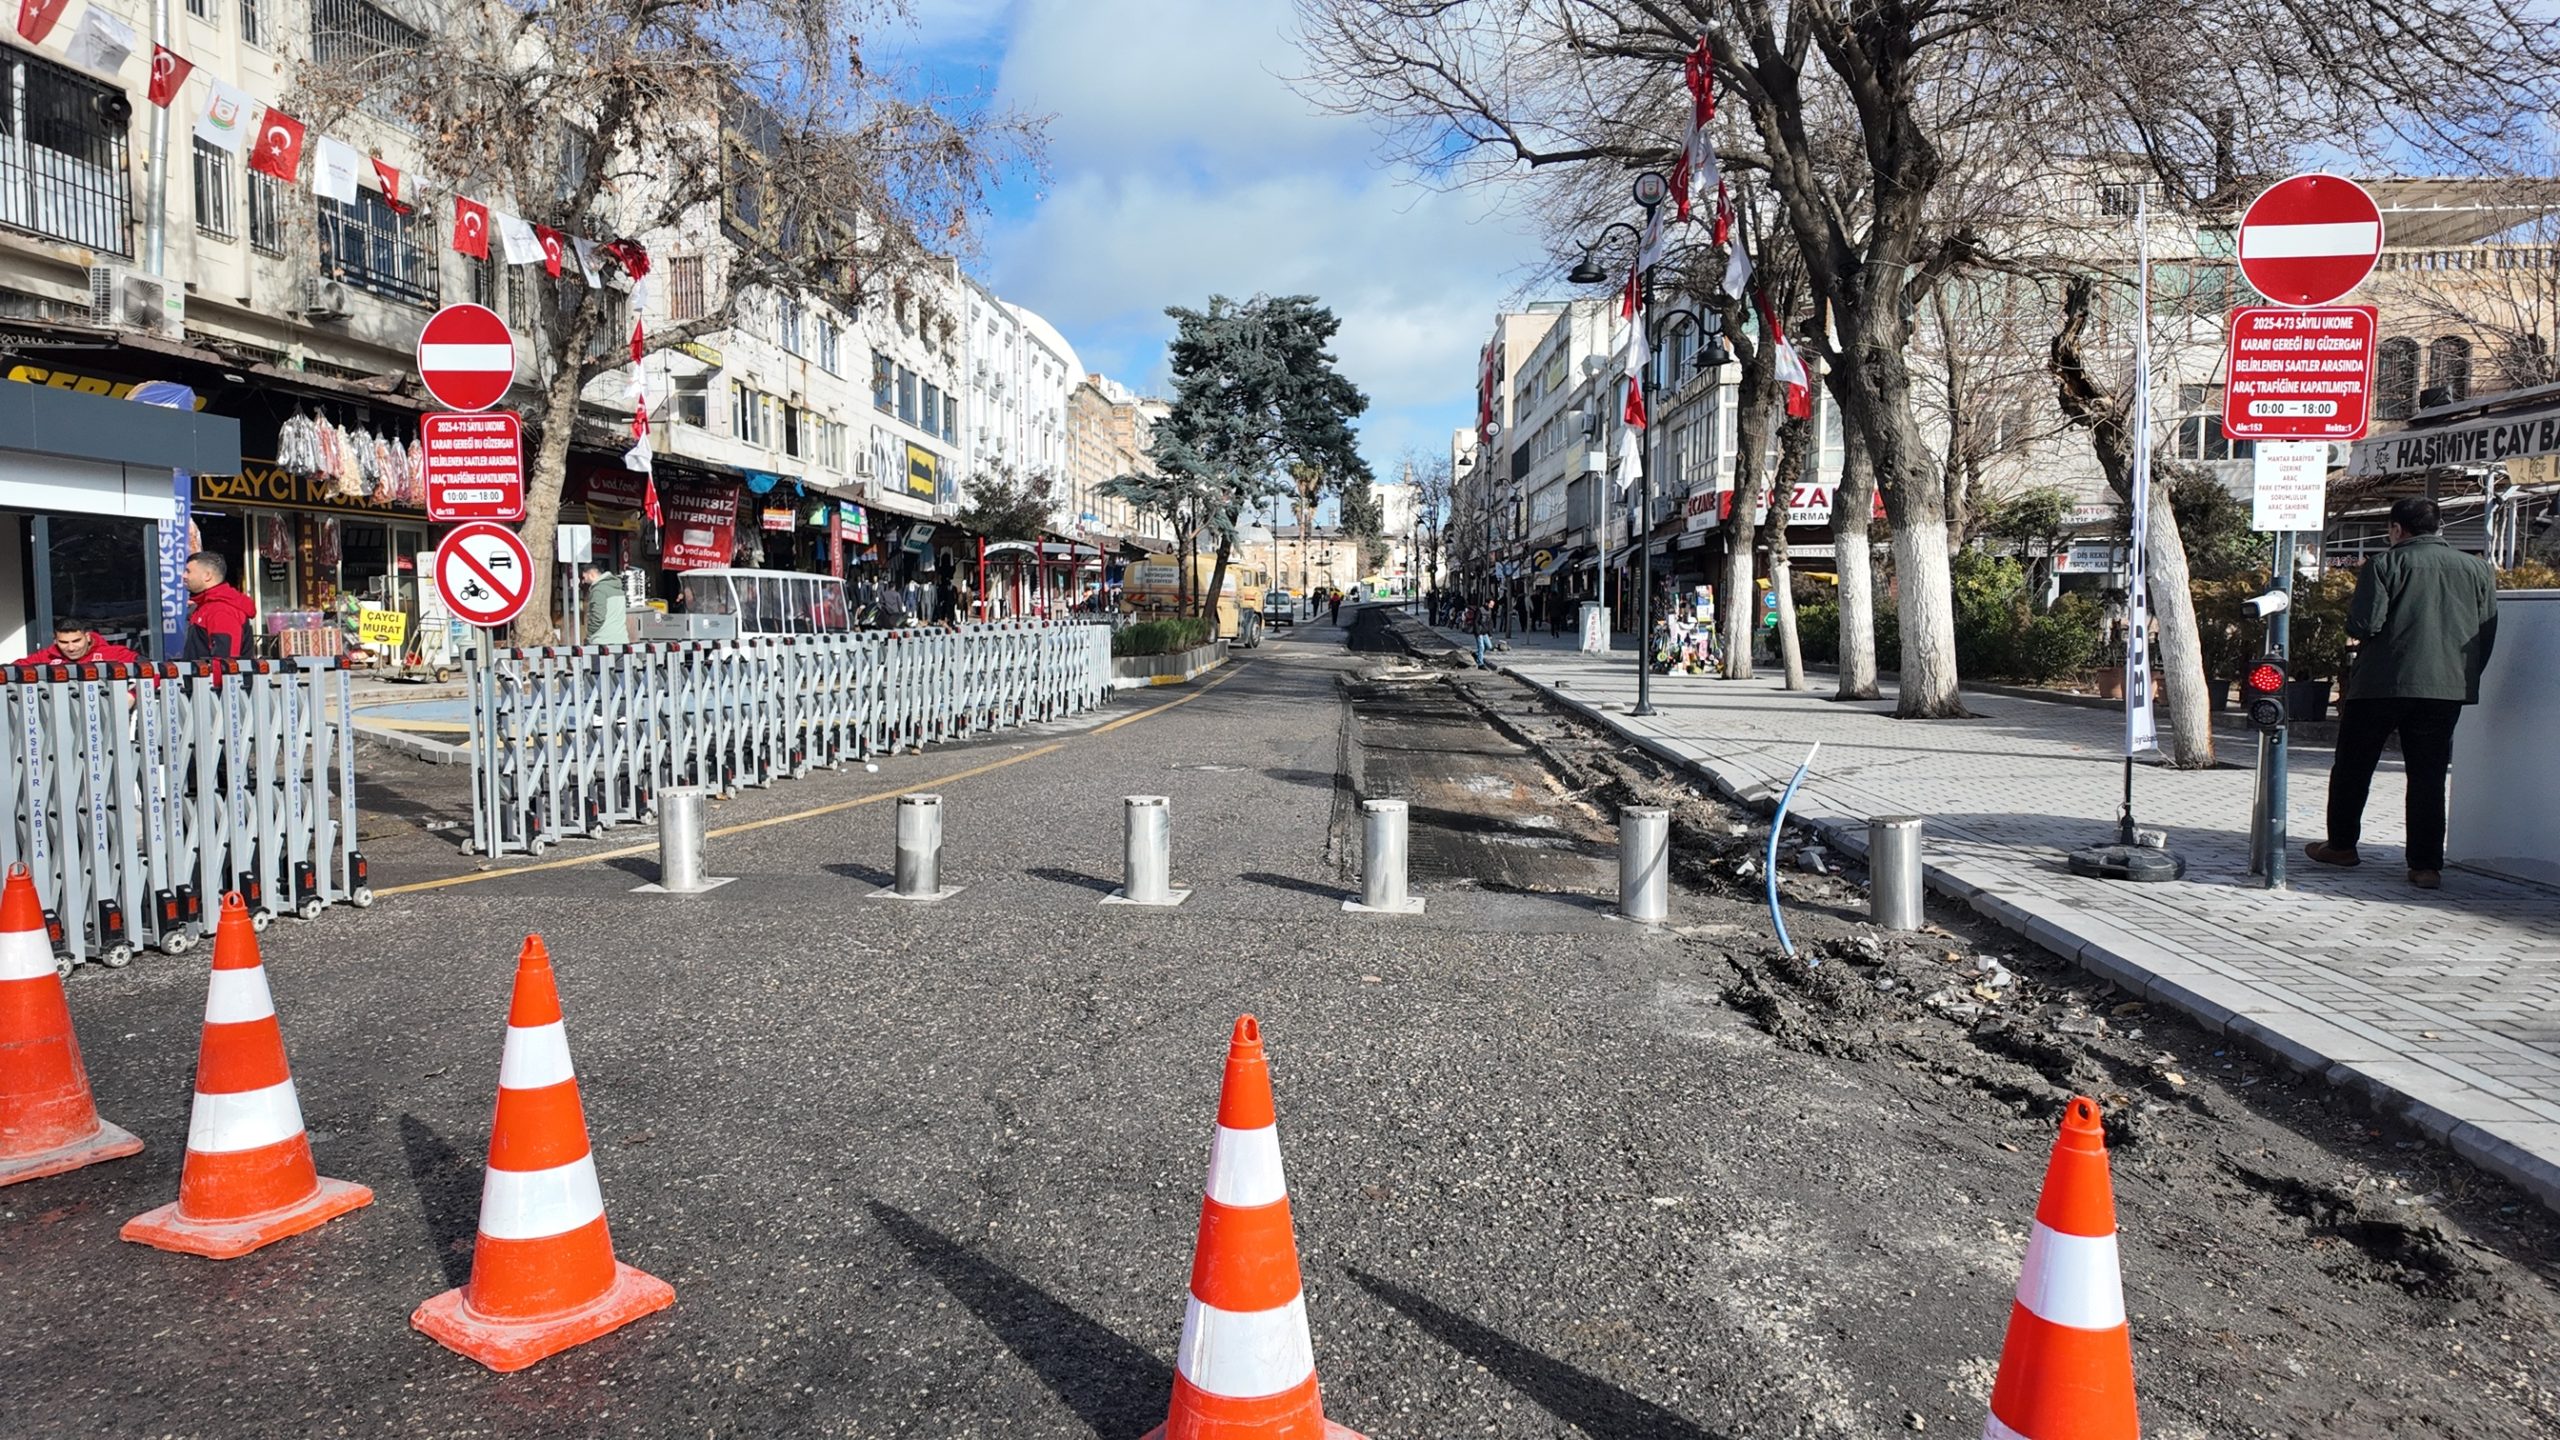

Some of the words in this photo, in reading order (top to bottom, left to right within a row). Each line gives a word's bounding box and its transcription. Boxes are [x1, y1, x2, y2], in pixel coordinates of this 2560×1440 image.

[2253, 317, 2294, 329] 2025-4-73
[2295, 316, 2321, 329] SAYILI
[2322, 316, 2353, 329] UKOME
[2240, 338, 2272, 350] KARARI
[2272, 335, 2302, 351] GEREĞİ
[2303, 338, 2316, 350] BU
[2316, 335, 2362, 350] GÜZERGAH
[2235, 357, 2284, 371] BELİRLENEN
[2285, 360, 2320, 372] SAATLER
[2321, 360, 2364, 372] ARASINDA
[2233, 381, 2256, 396] ARAÇ
[2257, 378, 2299, 393] TRAFİĞİNE
[2255, 403, 2284, 414] 10:00
[2302, 403, 2331, 414] 18:00
[2236, 423, 2263, 432] Alo:153
[2325, 424, 2352, 432] Nokta:1
[2493, 421, 2536, 460] ÇAY
[447, 492, 467, 500] 10:00
[479, 491, 499, 500] 18:00
[672, 495, 734, 511] SINIRSIZ
[1688, 490, 1716, 516] ECZANE
[669, 508, 733, 526] İNTERNET
[685, 547, 721, 558] vodafone
[664, 556, 687, 566] ASEL
[158, 519, 177, 634] BÜYÜKŞE
[367, 611, 399, 623] ÇAYCI
[363, 623, 401, 634] MURAT
[152, 786, 162, 842] ZABITA
[173, 782, 181, 837] ZABITA
[34, 799, 45, 858] ZABITA
[95, 793, 105, 851] ZABITA
